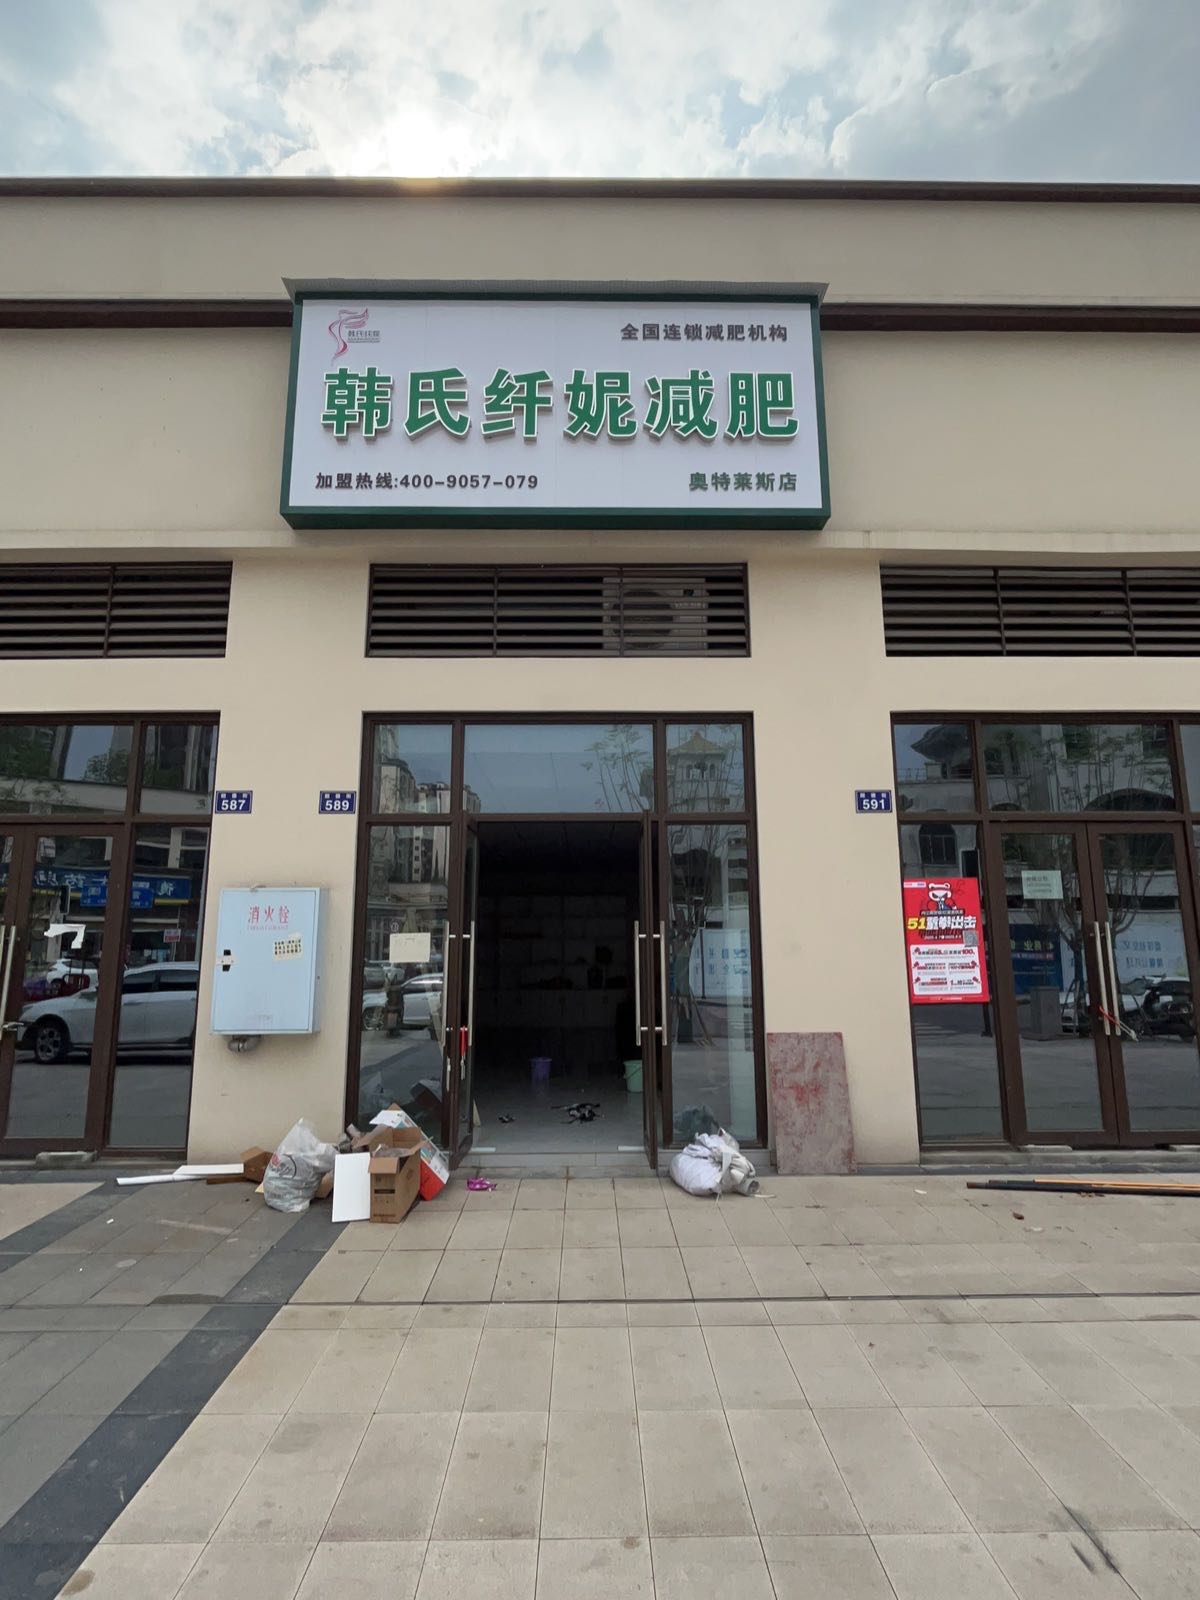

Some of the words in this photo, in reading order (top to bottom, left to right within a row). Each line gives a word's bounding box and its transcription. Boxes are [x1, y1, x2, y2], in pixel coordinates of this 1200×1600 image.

[620, 323, 788, 342] 全国连锁减肥机构
[320, 366, 800, 439] 韩氏纤妮减肥
[689, 472, 797, 491] 奥特莱斯店
[221, 799, 246, 810] 587
[325, 799, 350, 810] 589
[862, 799, 885, 810] 591
[248, 905, 289, 924] 消火栓
